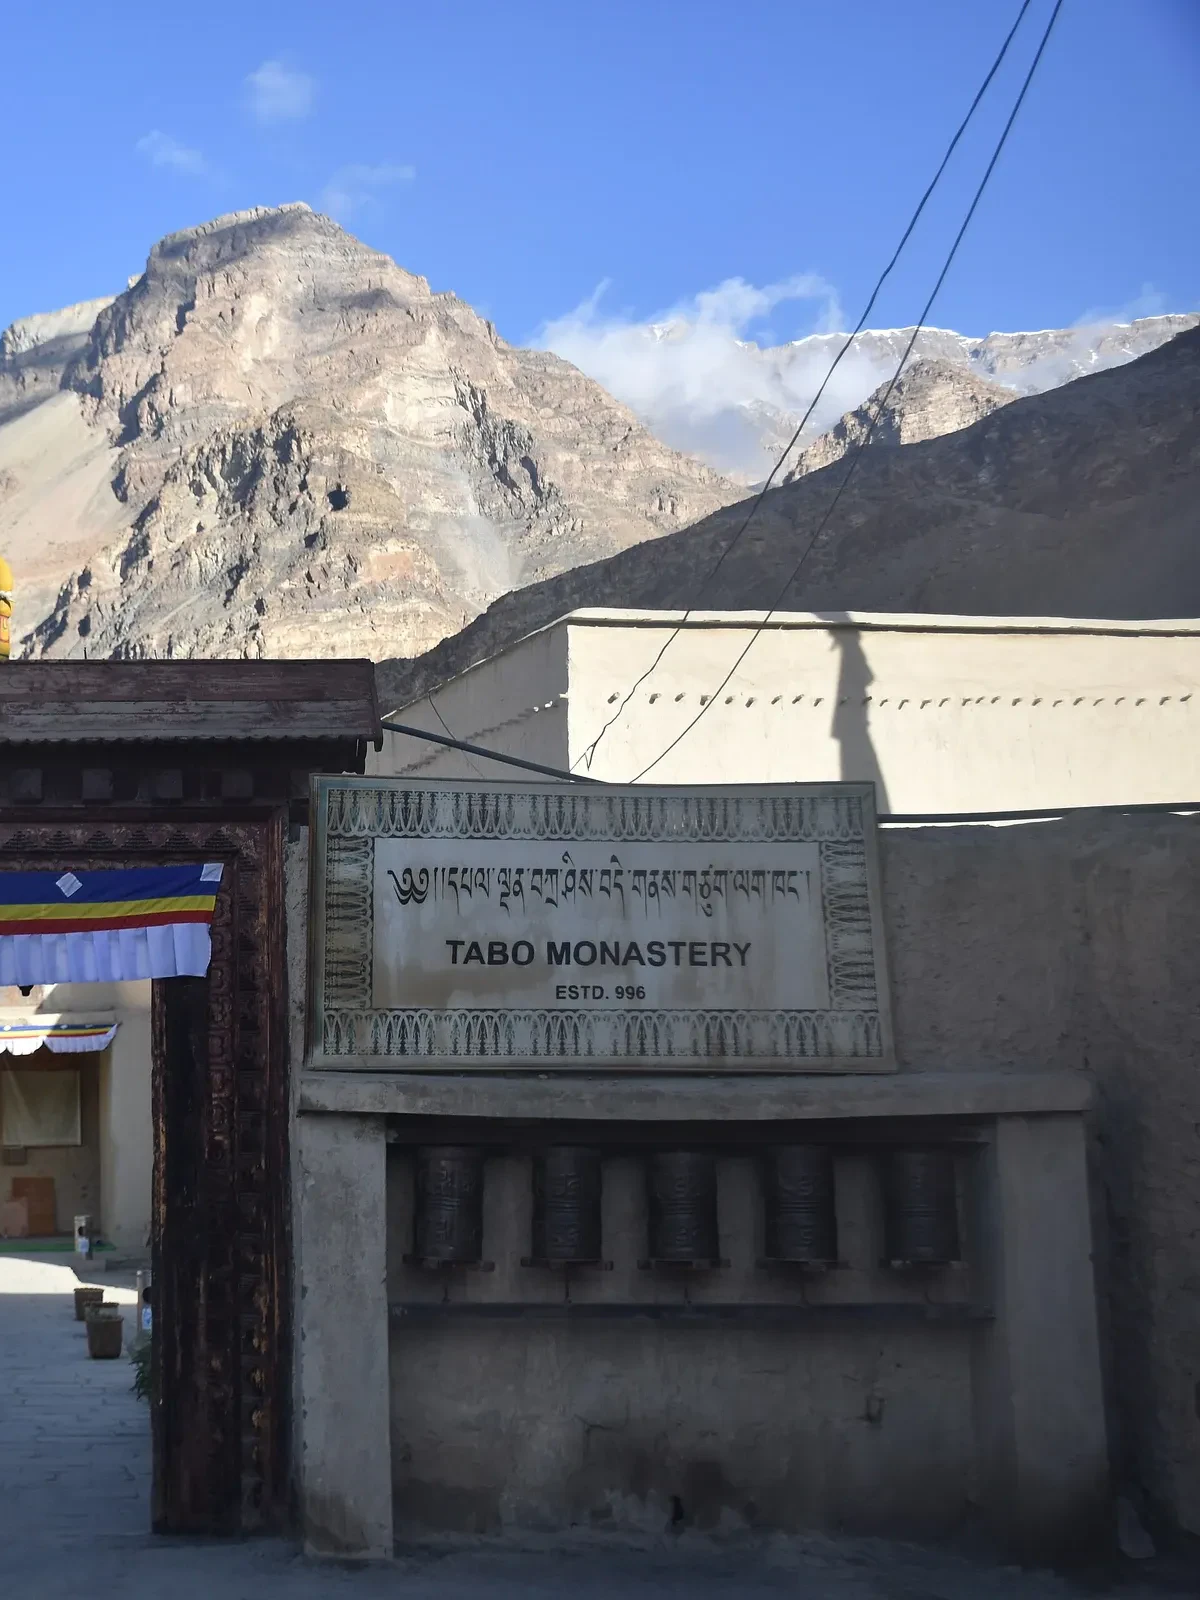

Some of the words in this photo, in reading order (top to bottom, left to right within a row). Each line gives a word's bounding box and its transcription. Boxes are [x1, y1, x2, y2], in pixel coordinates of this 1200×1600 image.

[446, 940, 535, 966] TABO
[547, 941, 752, 967] MONASTERY
[556, 985, 609, 1000] ESTD.
[615, 985, 646, 1000] 996
